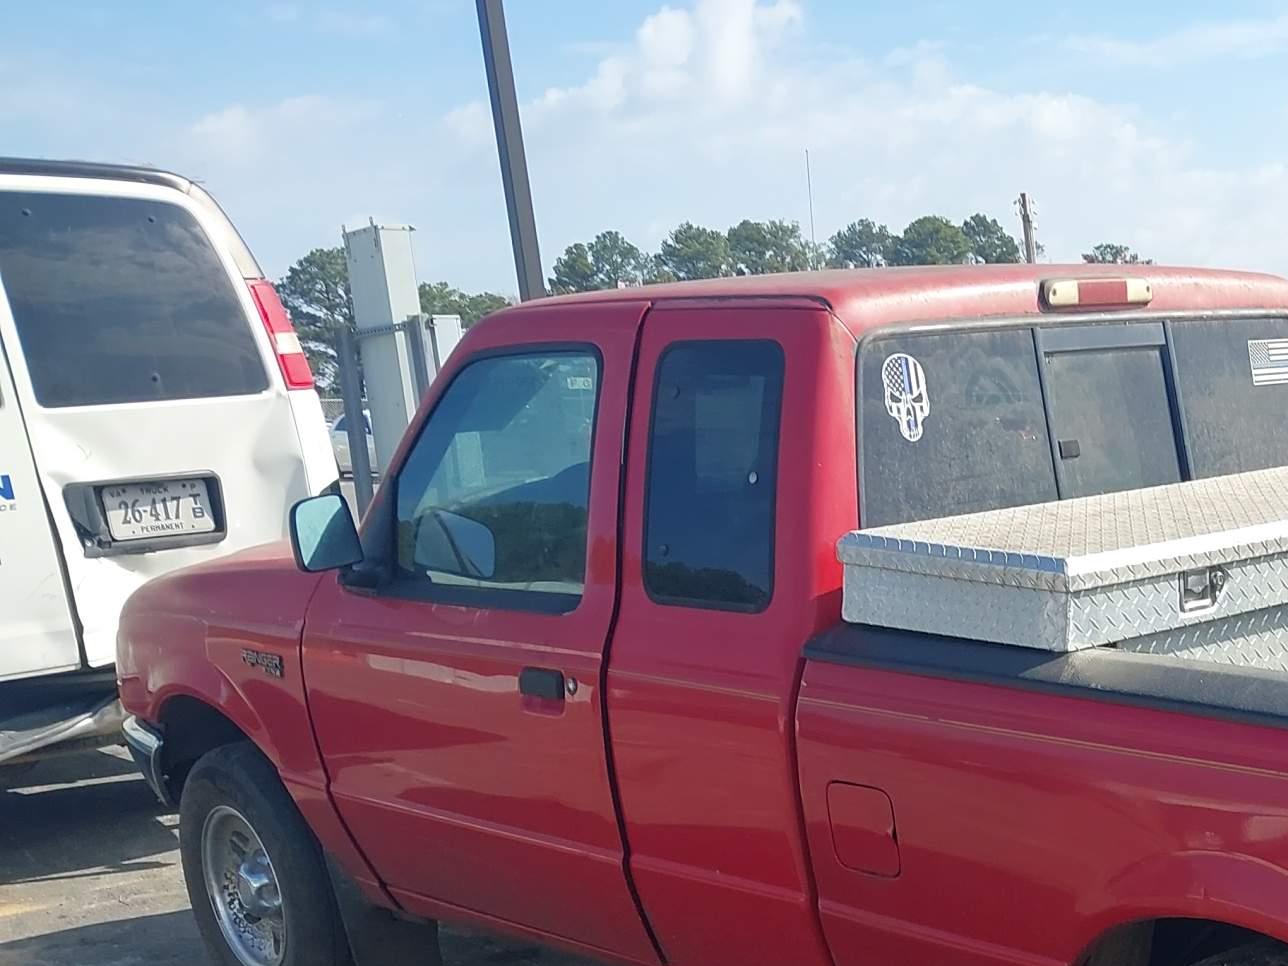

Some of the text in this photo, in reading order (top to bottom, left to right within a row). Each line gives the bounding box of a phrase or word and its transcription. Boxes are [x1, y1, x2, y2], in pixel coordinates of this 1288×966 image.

[139, 486, 169, 495] TRUCK
[118, 496, 181, 525] 26-417
[140, 522, 185, 534] PERMANENT
